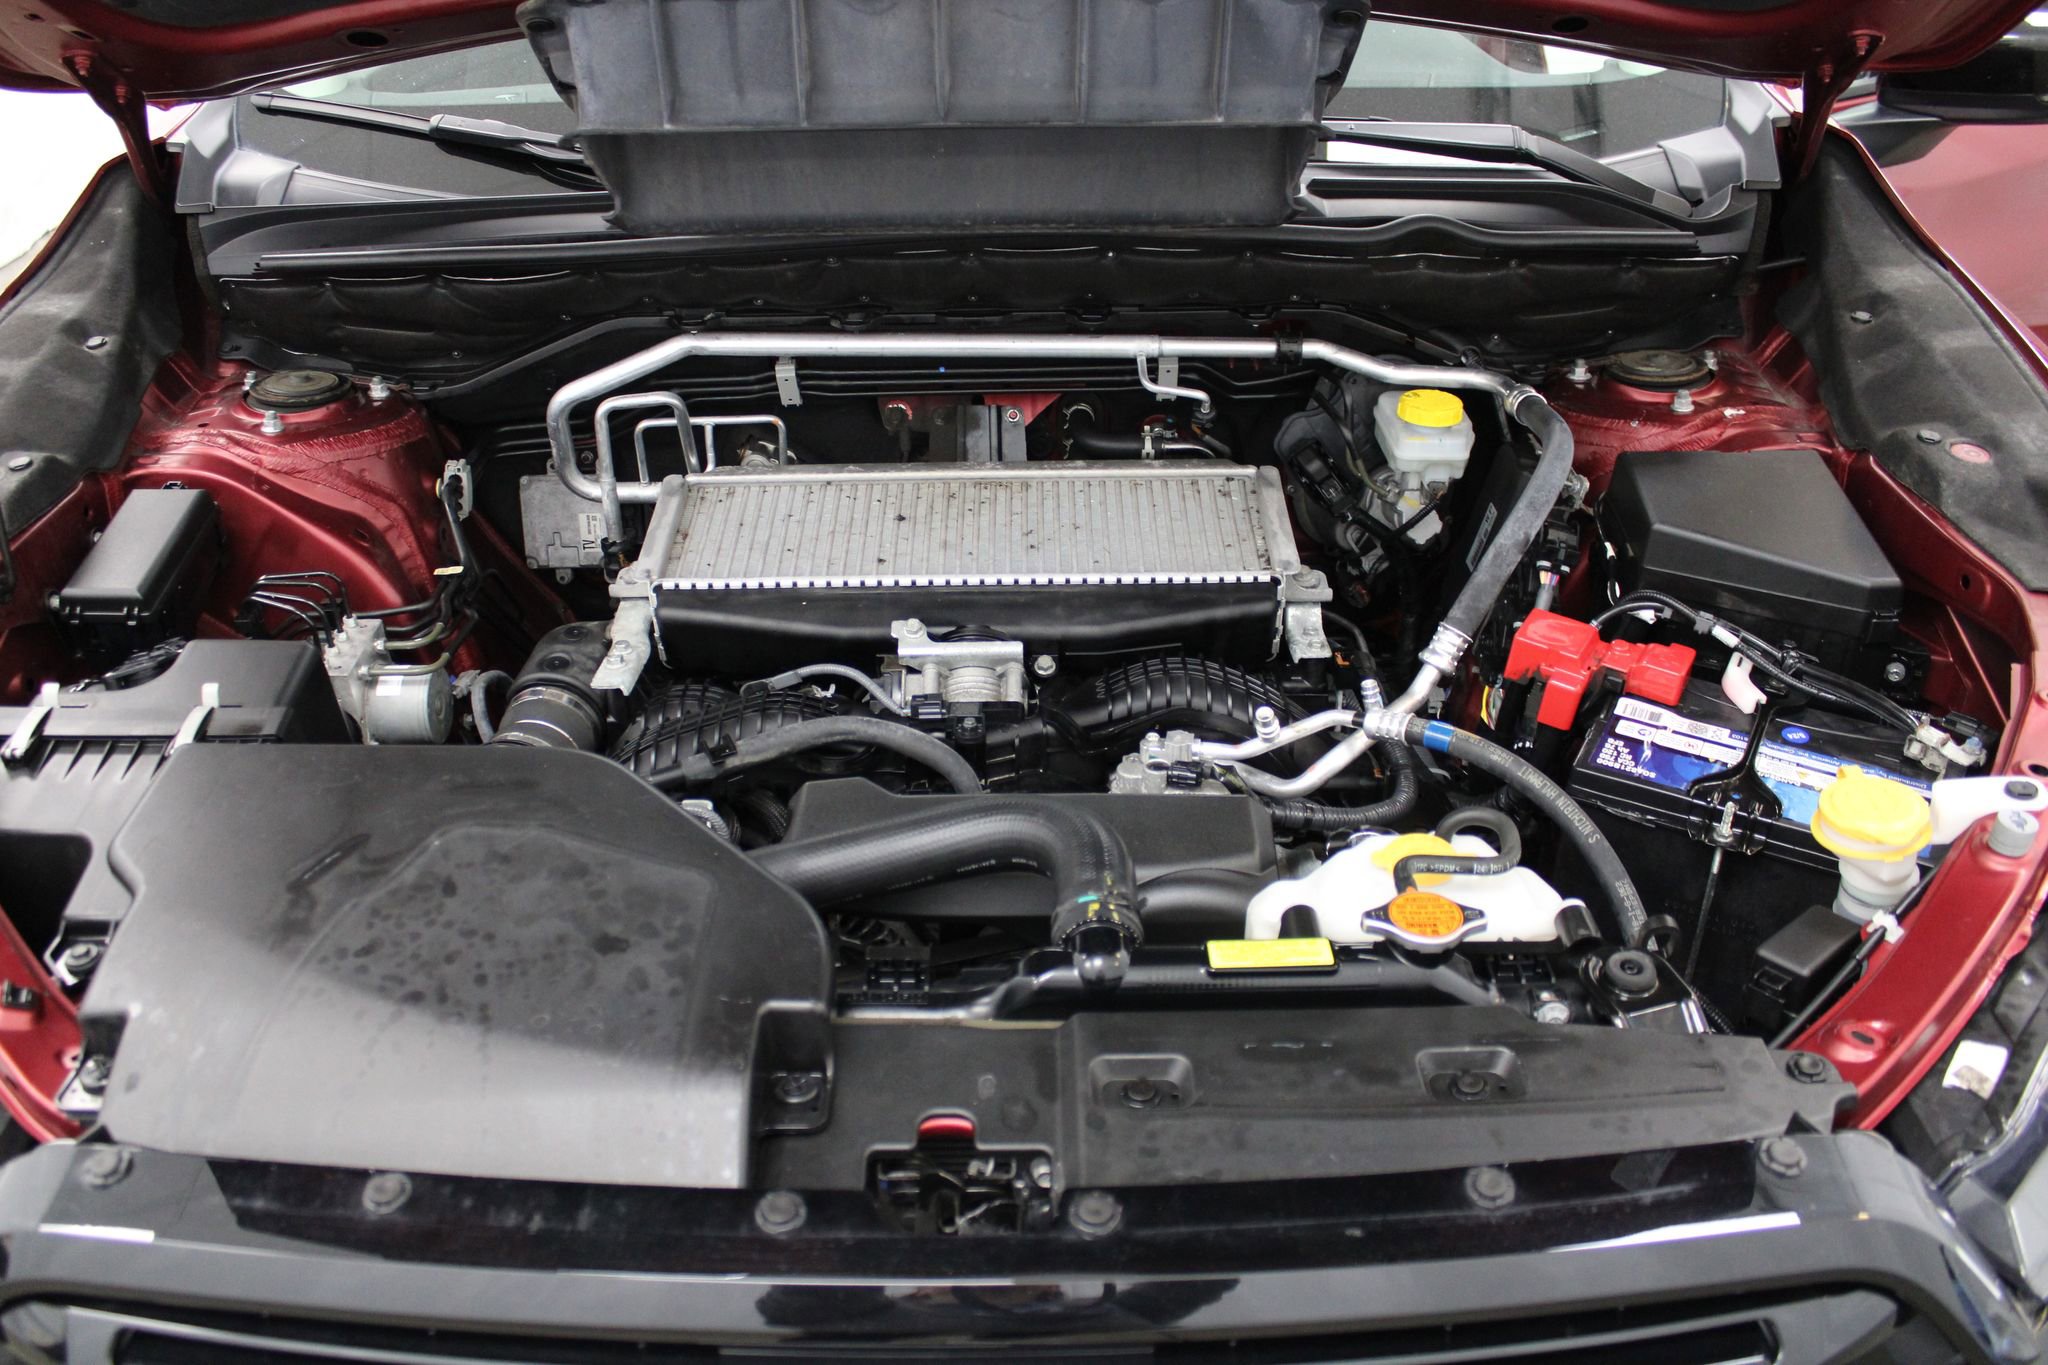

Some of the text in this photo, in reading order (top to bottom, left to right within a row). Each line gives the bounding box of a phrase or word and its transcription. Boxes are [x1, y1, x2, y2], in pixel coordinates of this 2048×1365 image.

[582, 539, 600, 551] TV
[1617, 745, 1630, 754] Ah
[1617, 757, 1635, 767] CCA
